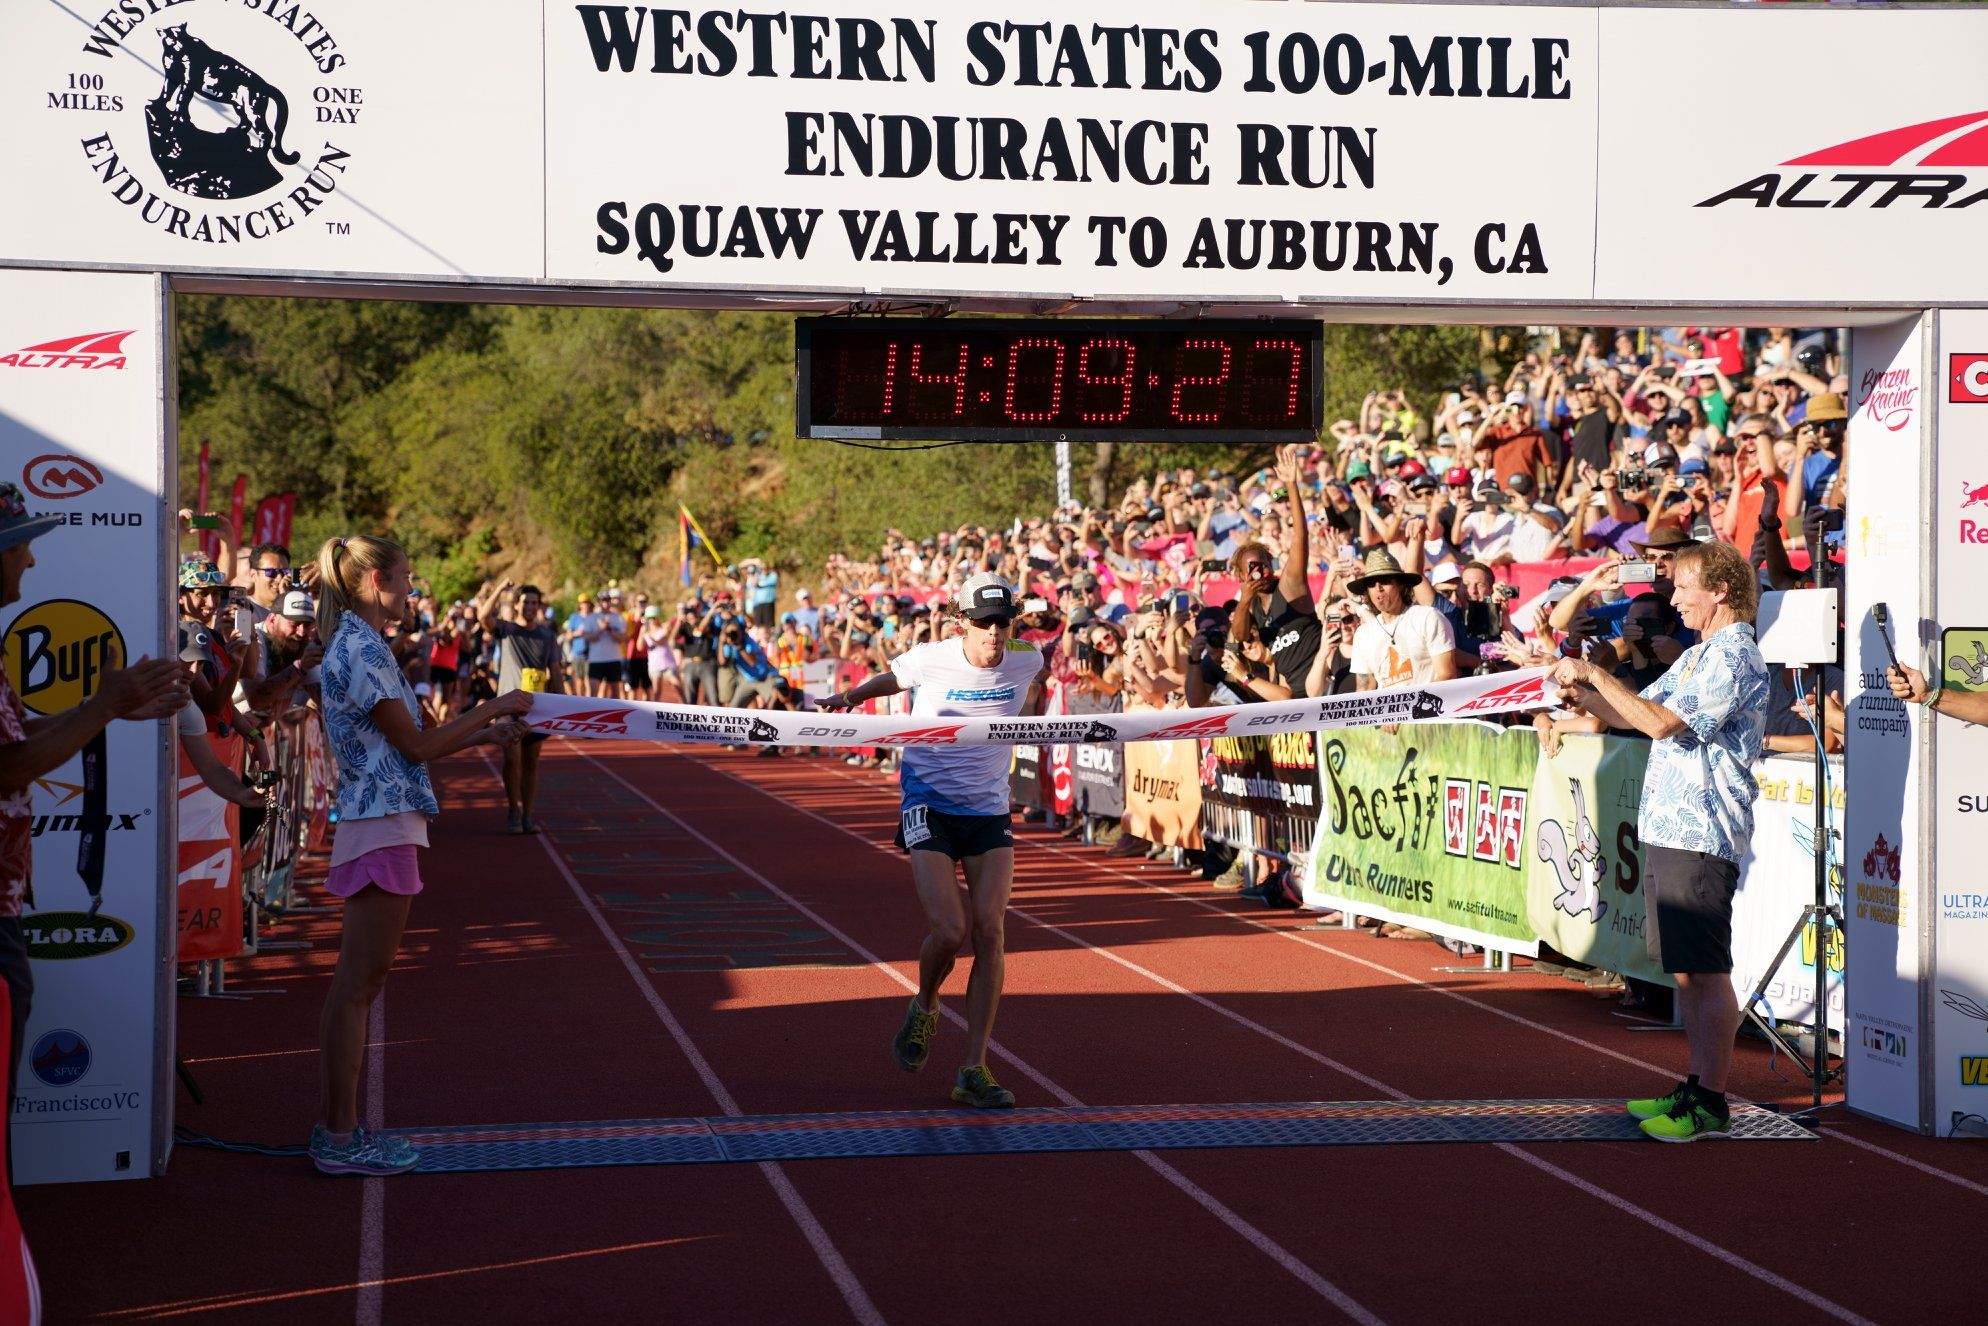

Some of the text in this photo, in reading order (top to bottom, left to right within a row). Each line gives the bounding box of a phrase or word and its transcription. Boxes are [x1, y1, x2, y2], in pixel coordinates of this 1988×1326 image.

[575, 5, 1571, 99] WESTERN STATES 100-MILE
[68, 72, 104, 90] 100
[47, 92, 124, 112] MILES
[313, 86, 362, 105] ONE
[315, 106, 361, 124] DAY
[784, 111, 1377, 189] ENDURANCE RUN
[82, 131, 351, 243] ENDURANCE RUN
[326, 222, 351, 235] TM
[597, 201, 1548, 286] SQUAW VALLEY TO AUBURN, CA
[0, 353, 127, 369] ALTRA
[92, 513, 142, 526] MUD
[1320, 690, 1415, 712] WESTERN STATES
[1453, 691, 1545, 712] ALTRA
[1858, 696, 1906, 717] running
[655, 711, 750, 726] WESTERN STATES
[1247, 712, 1305, 727] 2019
[1318, 702, 1411, 721] ENDURANCE RUN
[531, 720, 628, 735] ALTRA
[655, 721, 746, 734] ENDURANCE RUN
[798, 726, 858, 738] 2019
[987, 730, 1083, 740] ENDURANCE RUN
[988, 721, 1089, 732] WESTERN STATES
[1132, 726, 1229, 740] ALTRA
[1858, 717, 1909, 737] company
[862, 736, 959, 744] ALTRA
[1326, 739, 1439, 852] Sacfit
[1957, 795, 1988, 813] SU
[1366, 861, 1434, 902] Runners
[23, 926, 119, 945] LORA
